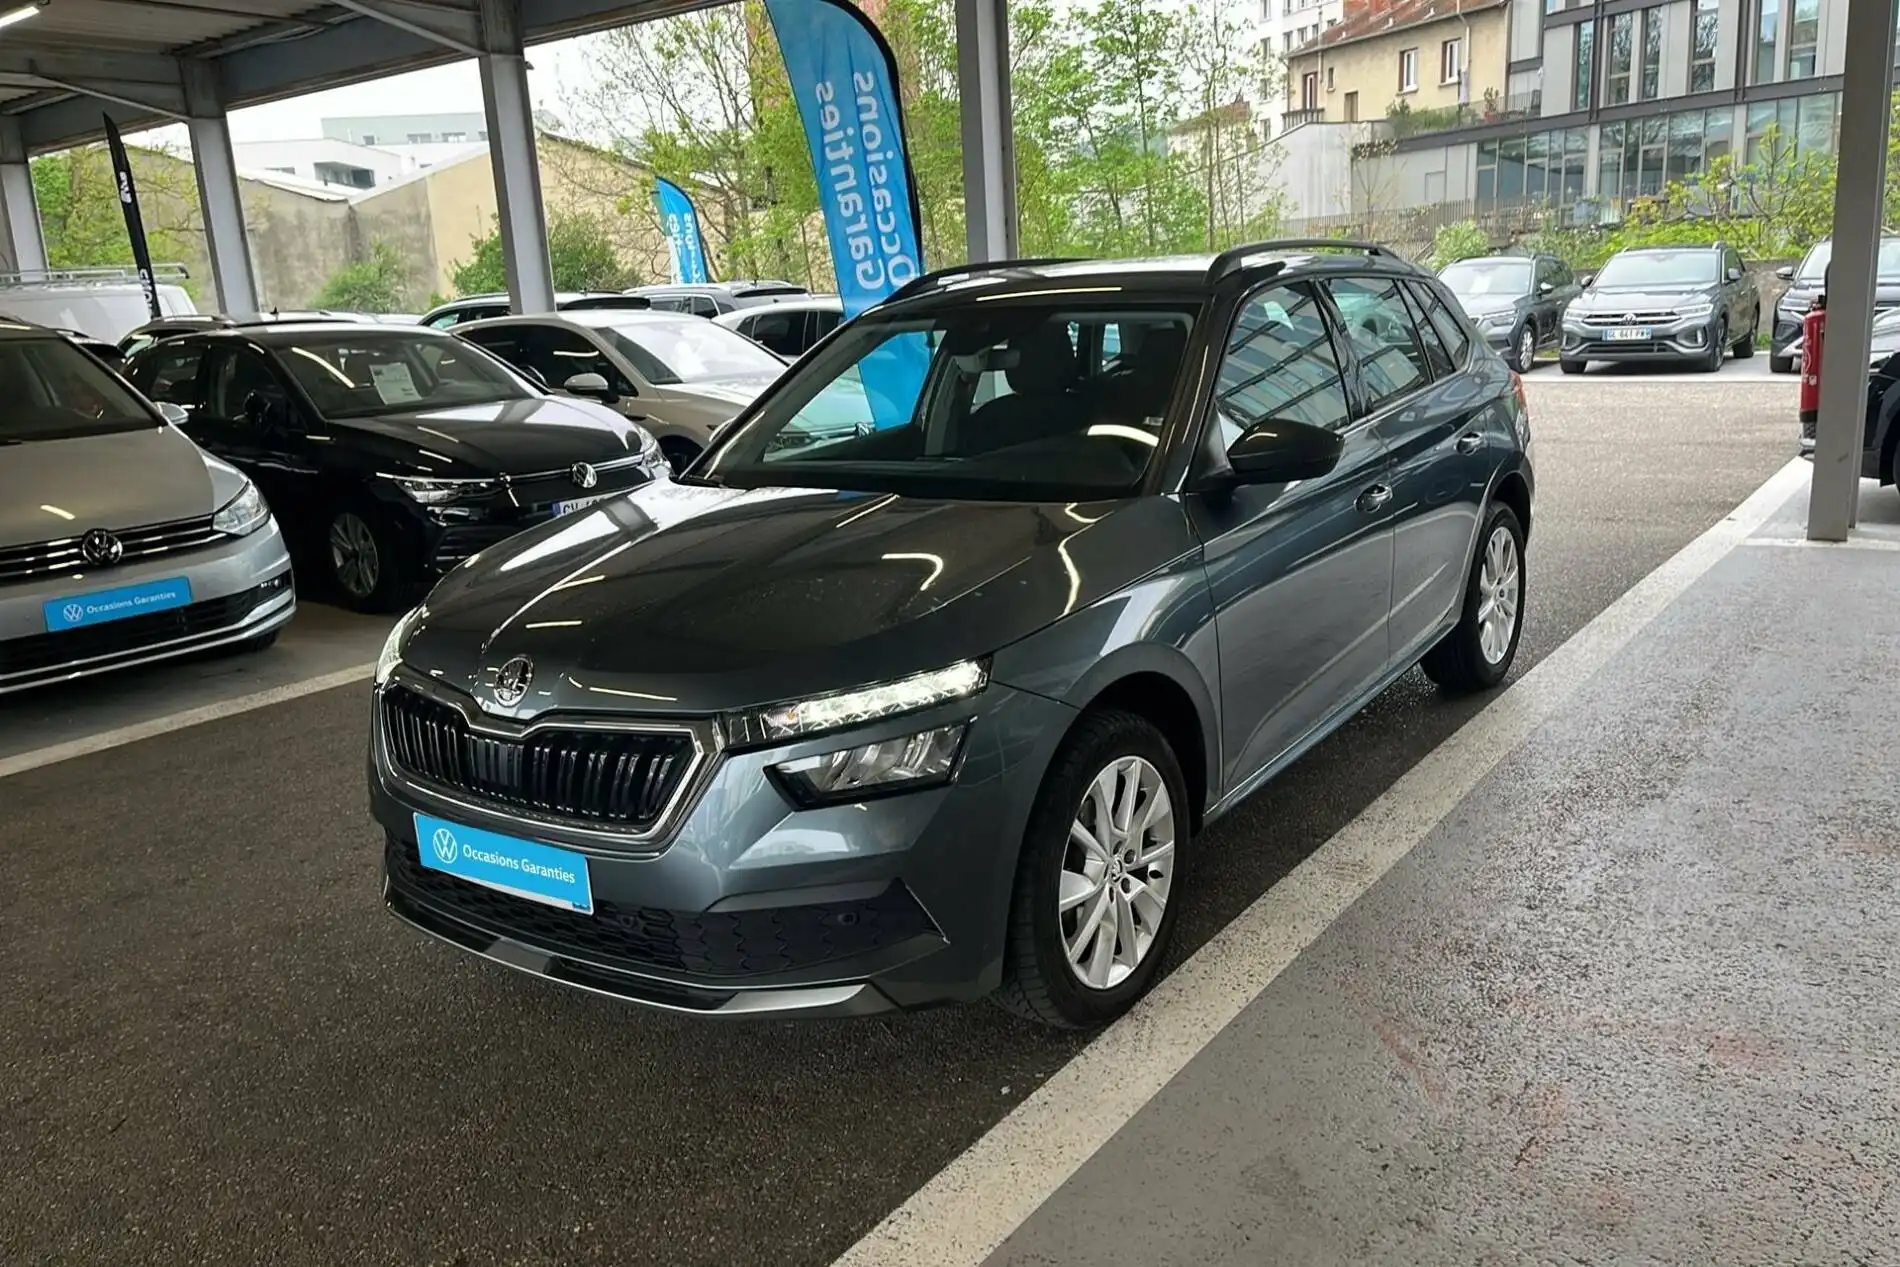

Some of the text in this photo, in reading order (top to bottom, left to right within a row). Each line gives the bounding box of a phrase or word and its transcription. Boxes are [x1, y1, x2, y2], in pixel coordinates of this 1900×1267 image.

[86, 599, 133, 615] Occasions
[134, 591, 176, 605] Garanties
[462, 844, 519, 870] Occasions
[521, 858, 576, 884] Garanties
